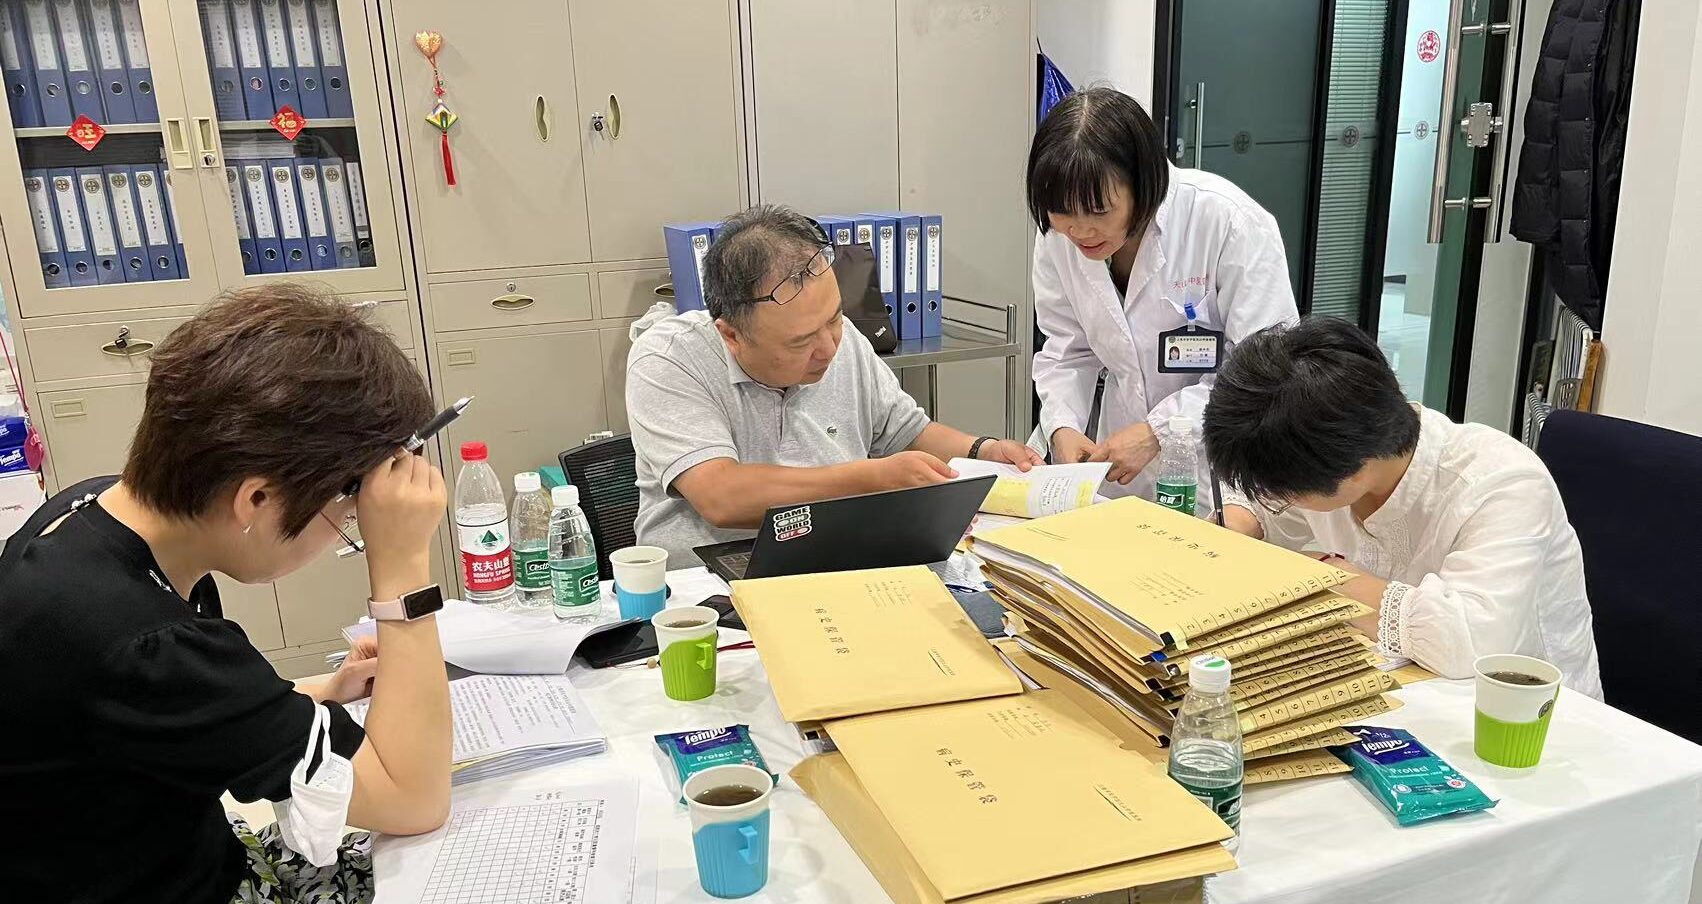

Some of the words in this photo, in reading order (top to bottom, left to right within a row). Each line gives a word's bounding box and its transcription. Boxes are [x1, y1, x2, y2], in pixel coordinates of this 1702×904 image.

[277, 112, 297, 128] 福
[776, 507, 809, 521] GAME
[789, 515, 805, 523] ON
[777, 520, 809, 533] WORLD
[780, 531, 796, 539] OFF
[472, 557, 510, 572] 农夫山泉
[1308, 580, 1317, 589] 10
[1322, 575, 1332, 584] 11
[1352, 683, 1361, 693] 10
[1367, 679, 1376, 688] 11
[1381, 674, 1391, 684] 12
[1352, 708, 1363, 717] 10
[1367, 705, 1376, 713] 11
[682, 728, 726, 745] Tempo
[1362, 740, 1403, 753] Tempo
[697, 751, 733, 761] Protect
[1296, 765, 1306, 773] 10
[1390, 766, 1429, 775] Protect
